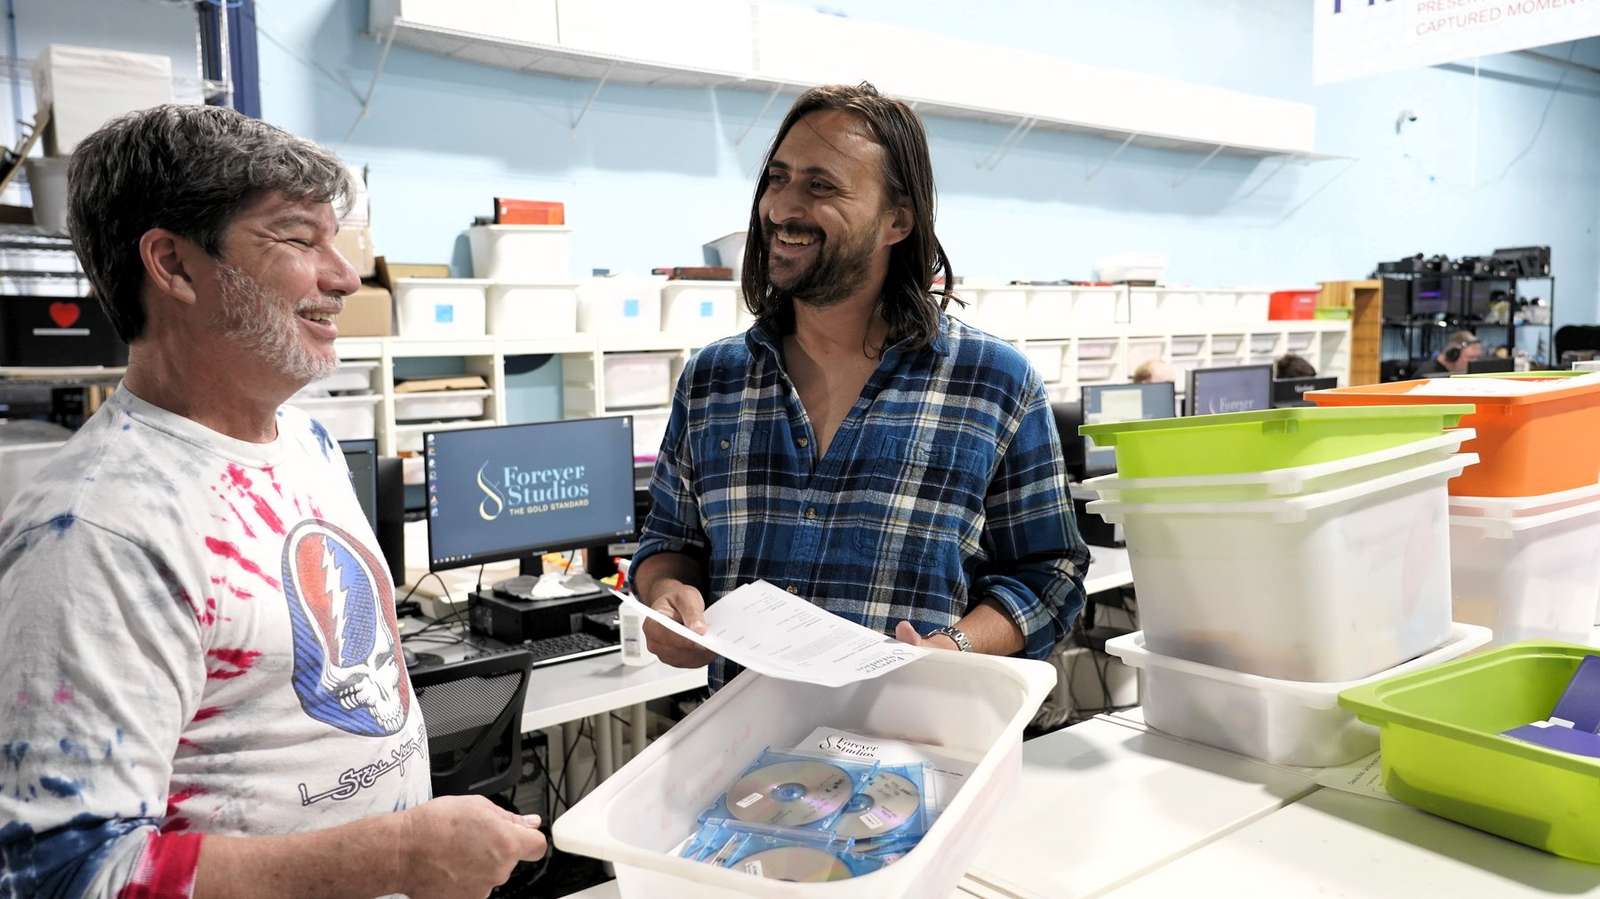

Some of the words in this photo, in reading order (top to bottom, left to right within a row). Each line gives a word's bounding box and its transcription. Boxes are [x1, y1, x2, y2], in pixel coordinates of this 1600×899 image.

[1416, 7, 1501, 36] CAPTURED
[504, 465, 585, 487] Forever
[508, 480, 590, 506] Studios
[509, 507, 525, 516] THE
[526, 503, 549, 514] GOLD
[550, 499, 590, 511] STANDARD
